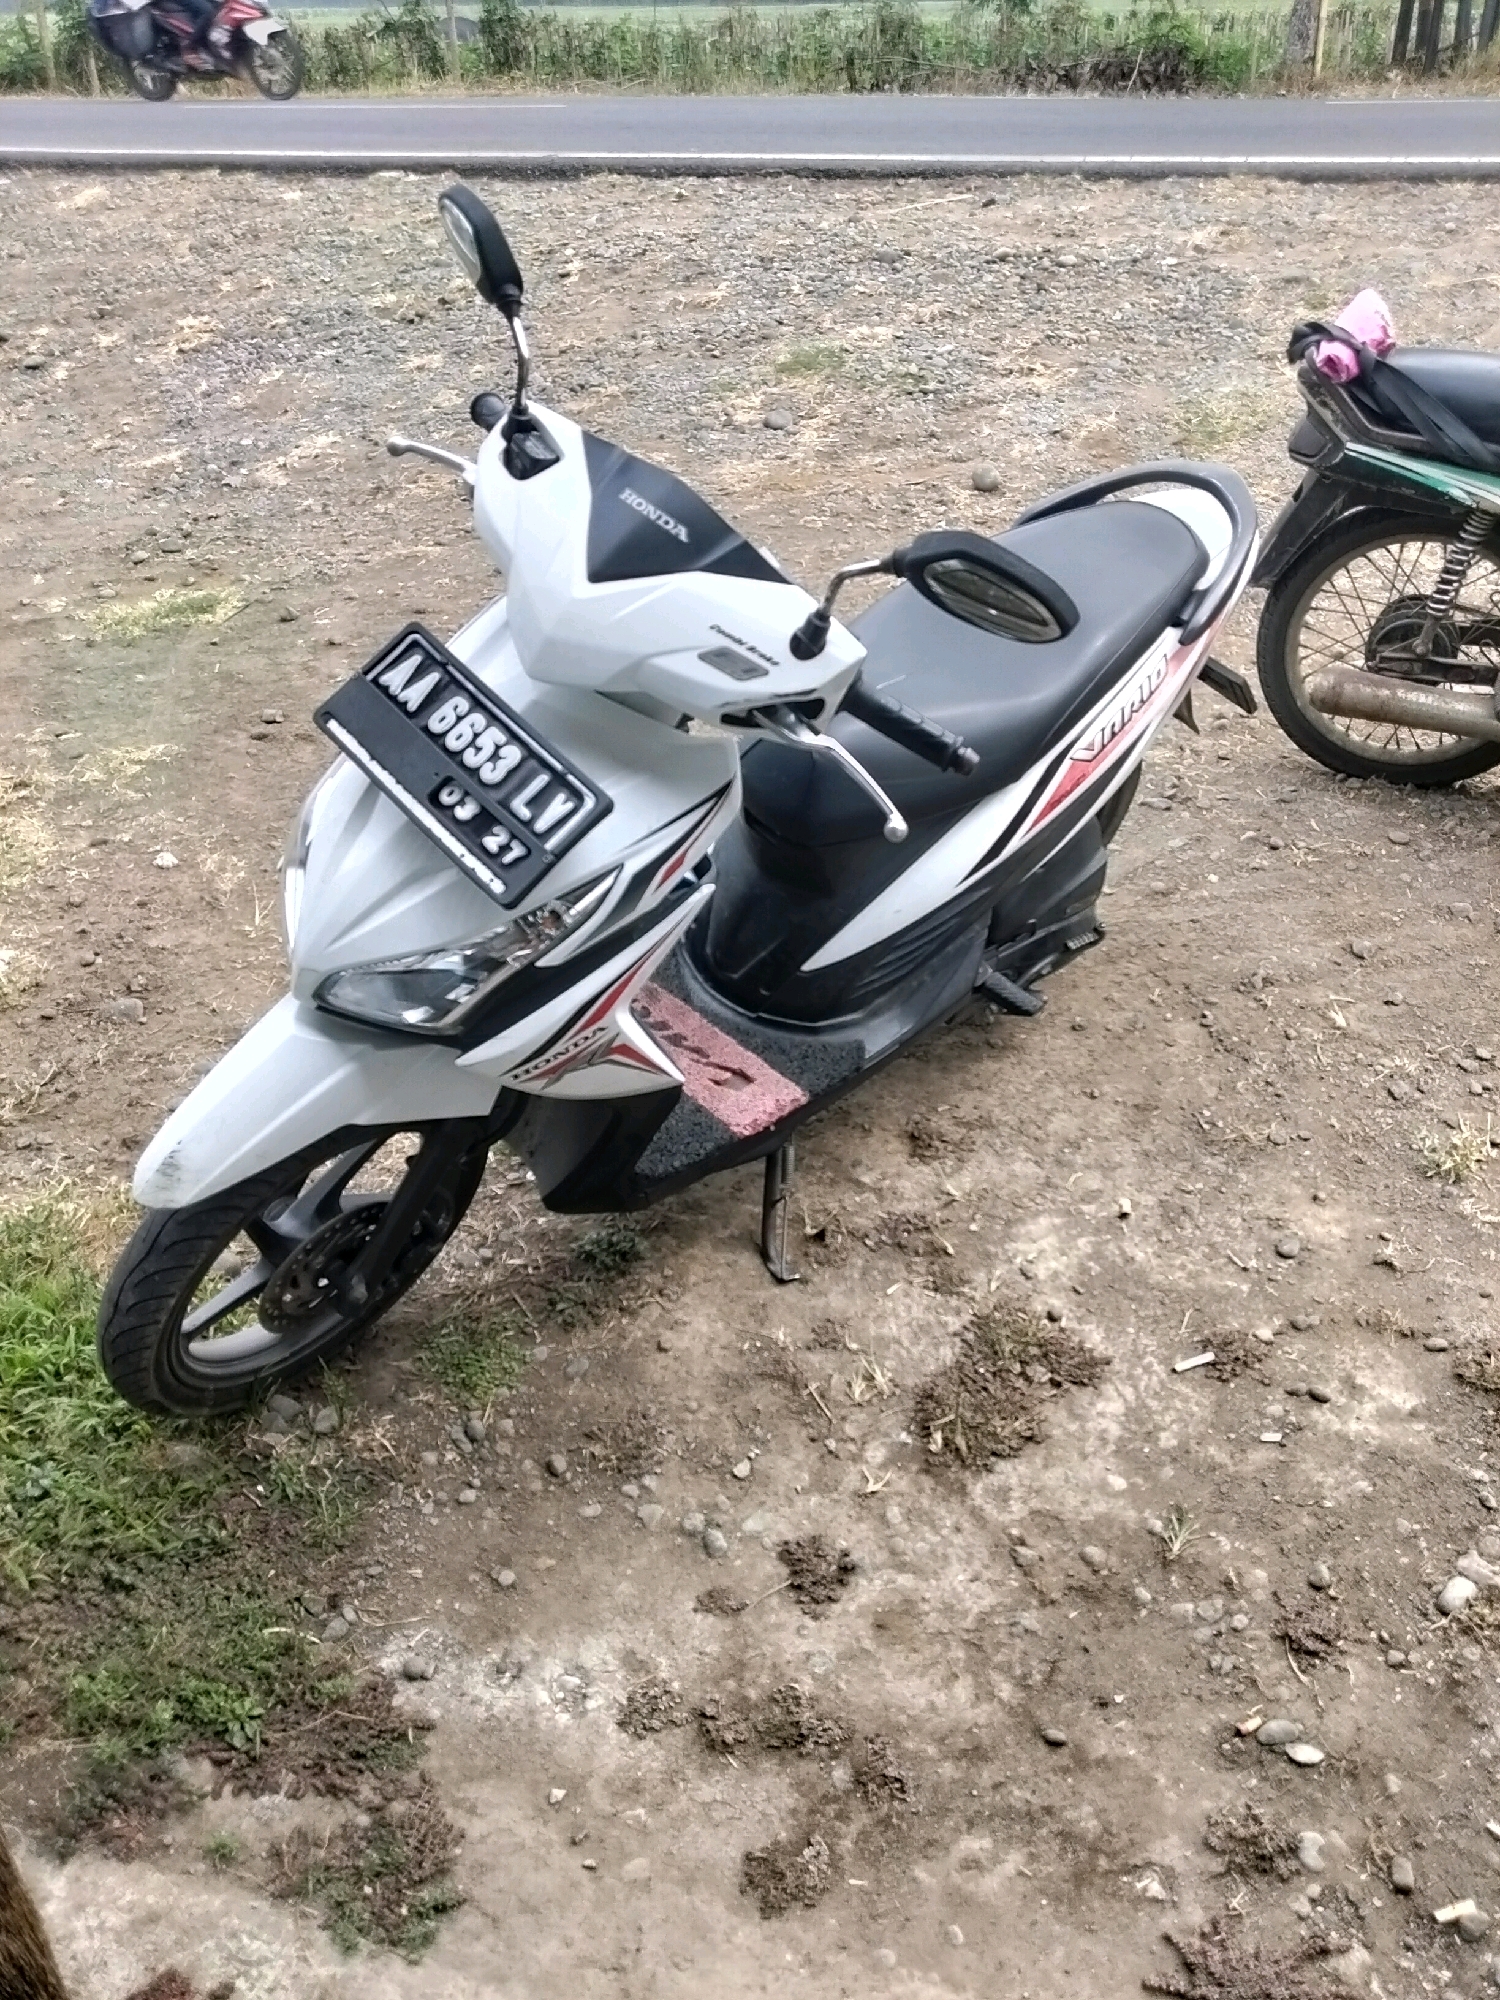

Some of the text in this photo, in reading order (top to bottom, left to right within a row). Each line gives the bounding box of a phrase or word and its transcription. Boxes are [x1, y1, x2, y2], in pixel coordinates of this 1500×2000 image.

[619, 487, 689, 543] HONDA
[379, 654, 441, 713] AA
[428, 696, 521, 784] 6653
[1070, 653, 1168, 762] VARIO
[438, 783, 528, 865] 03 27
[512, 1026, 608, 1080] HONDA
